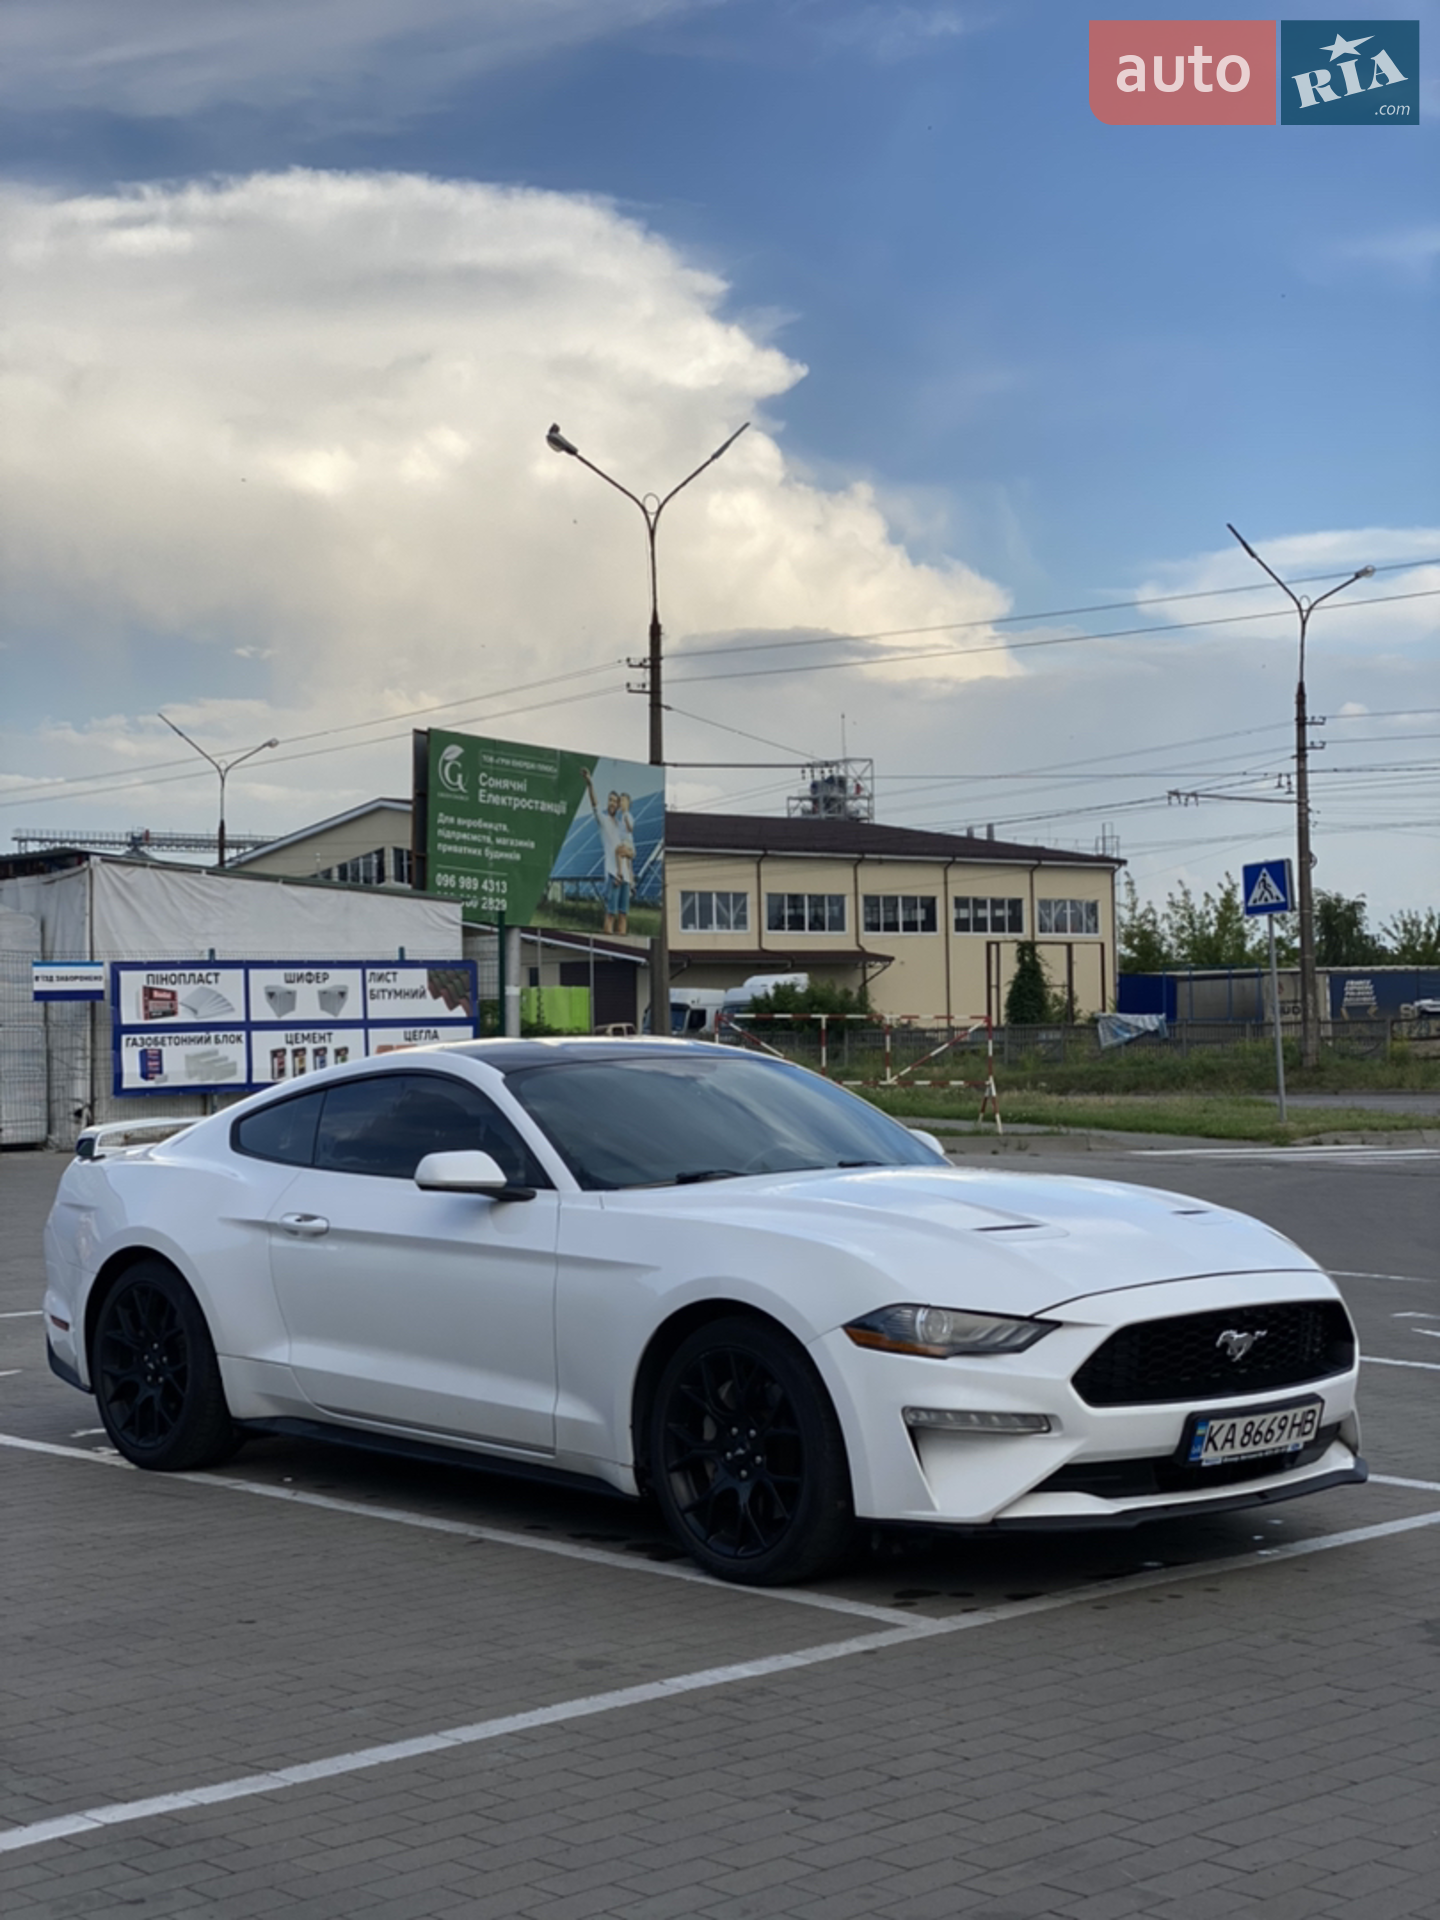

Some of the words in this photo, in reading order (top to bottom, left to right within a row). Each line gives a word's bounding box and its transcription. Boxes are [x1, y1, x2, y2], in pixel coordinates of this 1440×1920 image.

[478, 772, 527, 792] Сонячні
[478, 789, 567, 816] Електростанції
[437, 812, 455, 824] Для
[495, 836, 535, 849] магазинів
[437, 842, 482, 856] приватних
[484, 846, 521, 861] будинків
[435, 872, 456, 888] 096
[458, 876, 479, 891] 989
[481, 878, 508, 894] 4313
[146, 972, 221, 985] ПІНОПЛАСТ
[284, 971, 330, 984] ШИФЕР
[368, 971, 398, 983] ЛИСТ
[369, 985, 427, 1000] БІТУМНИЙ
[125, 1032, 212, 1048] ГАЗОБЕТОННИЙ
[214, 1034, 243, 1045] БЛОК
[285, 1031, 333, 1045] ЦЕМЕНТ
[403, 1029, 439, 1042] ЦЕГЛА
[1204, 1422, 1236, 1453] KA
[1240, 1415, 1289, 1447] 8669
[1287, 1409, 1317, 1440] HB
